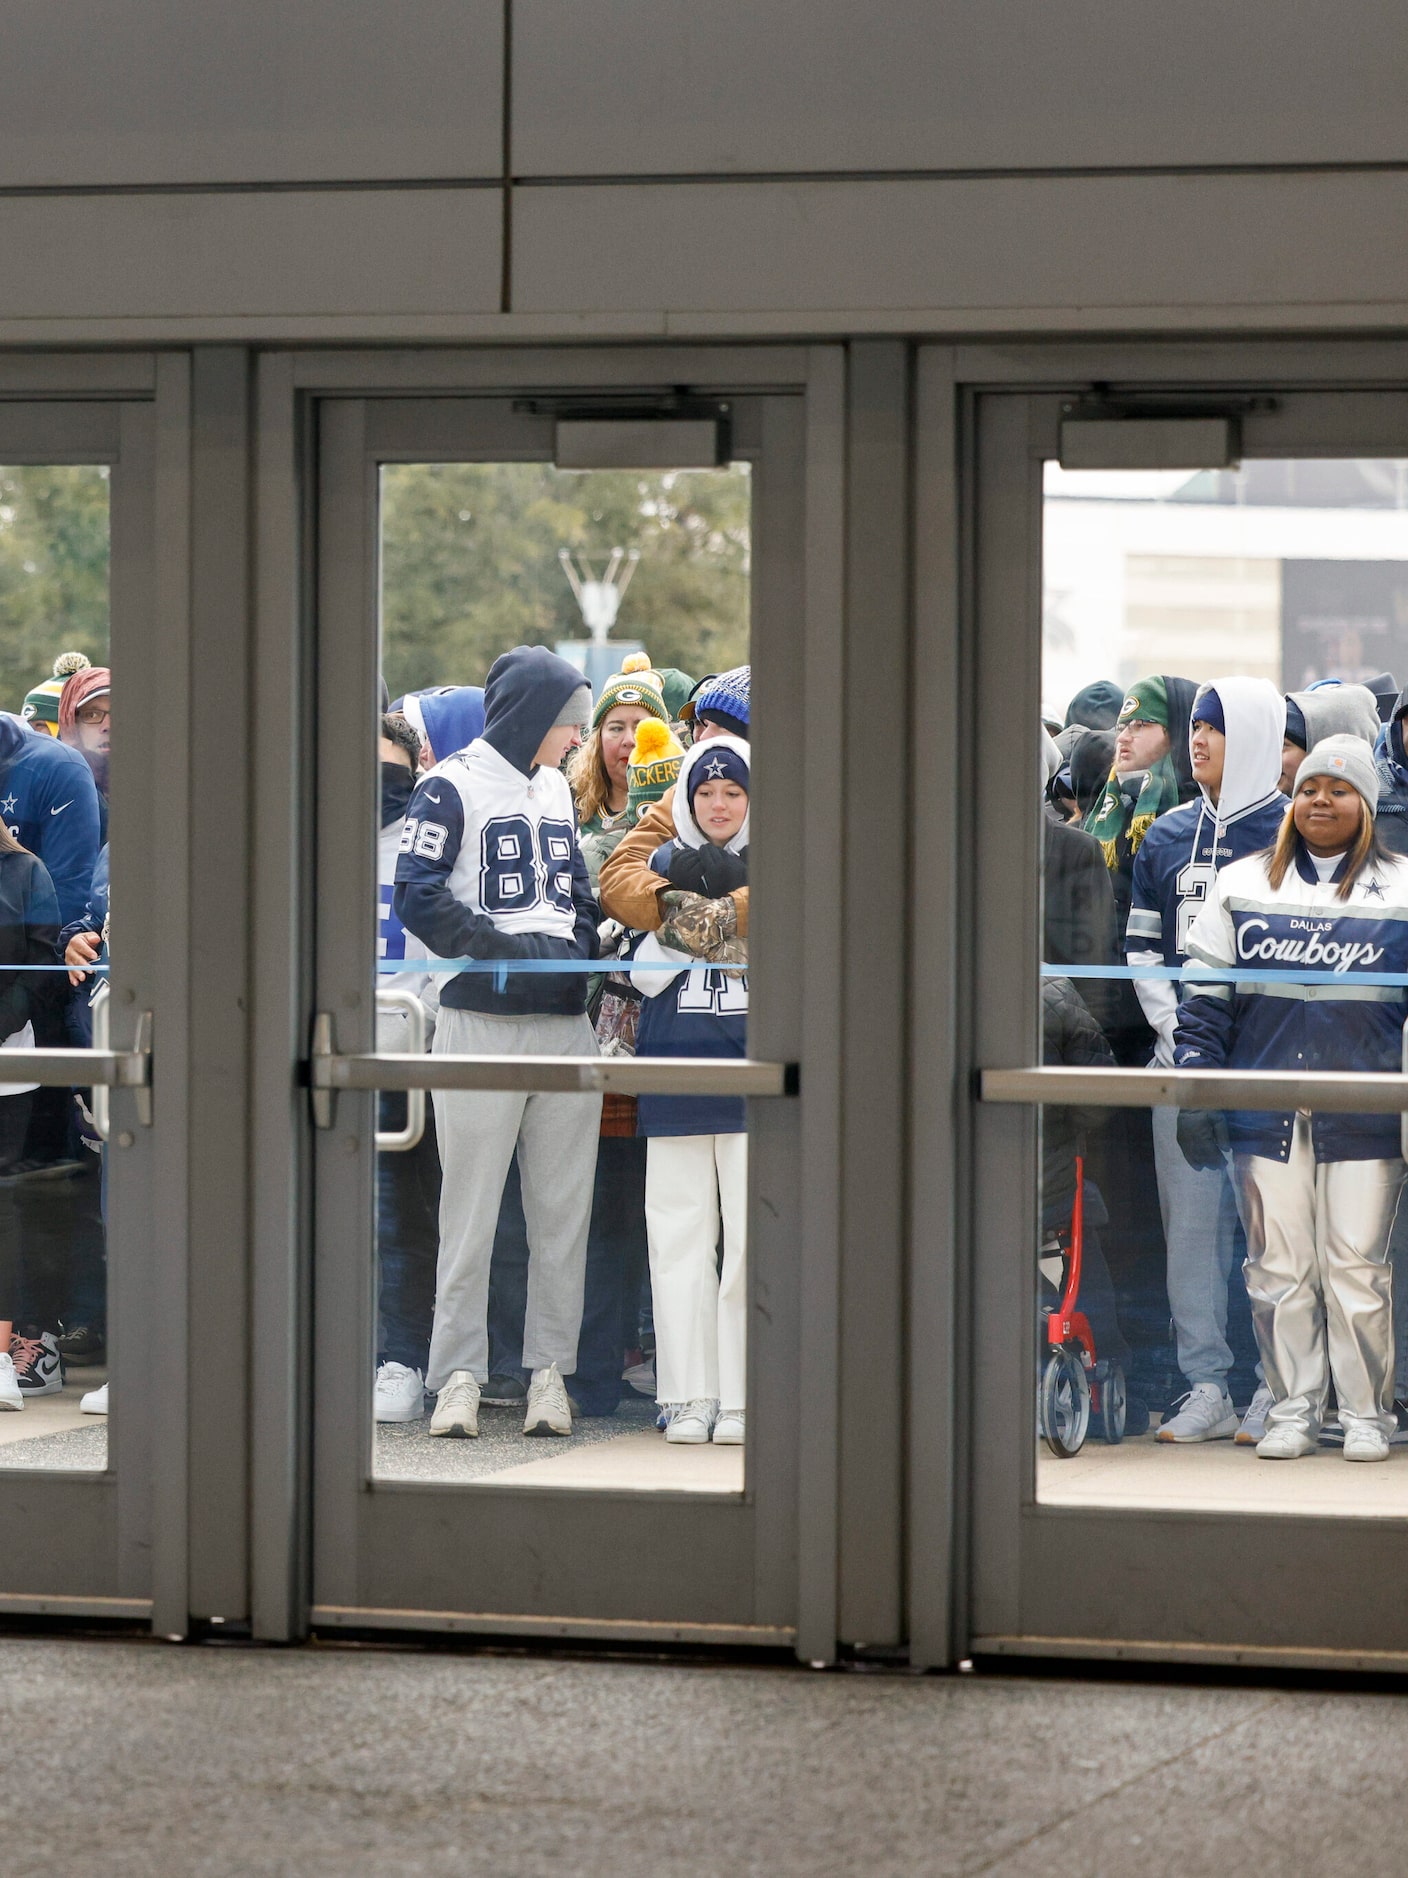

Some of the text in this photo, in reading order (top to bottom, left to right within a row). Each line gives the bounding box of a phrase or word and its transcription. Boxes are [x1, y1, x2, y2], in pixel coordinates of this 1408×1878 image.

[616, 688, 642, 703] G
[399, 817, 449, 861] 88
[479, 813, 577, 915] 88
[1237, 918, 1385, 977] Cowboys
[1289, 919, 1333, 932] DALLAS
